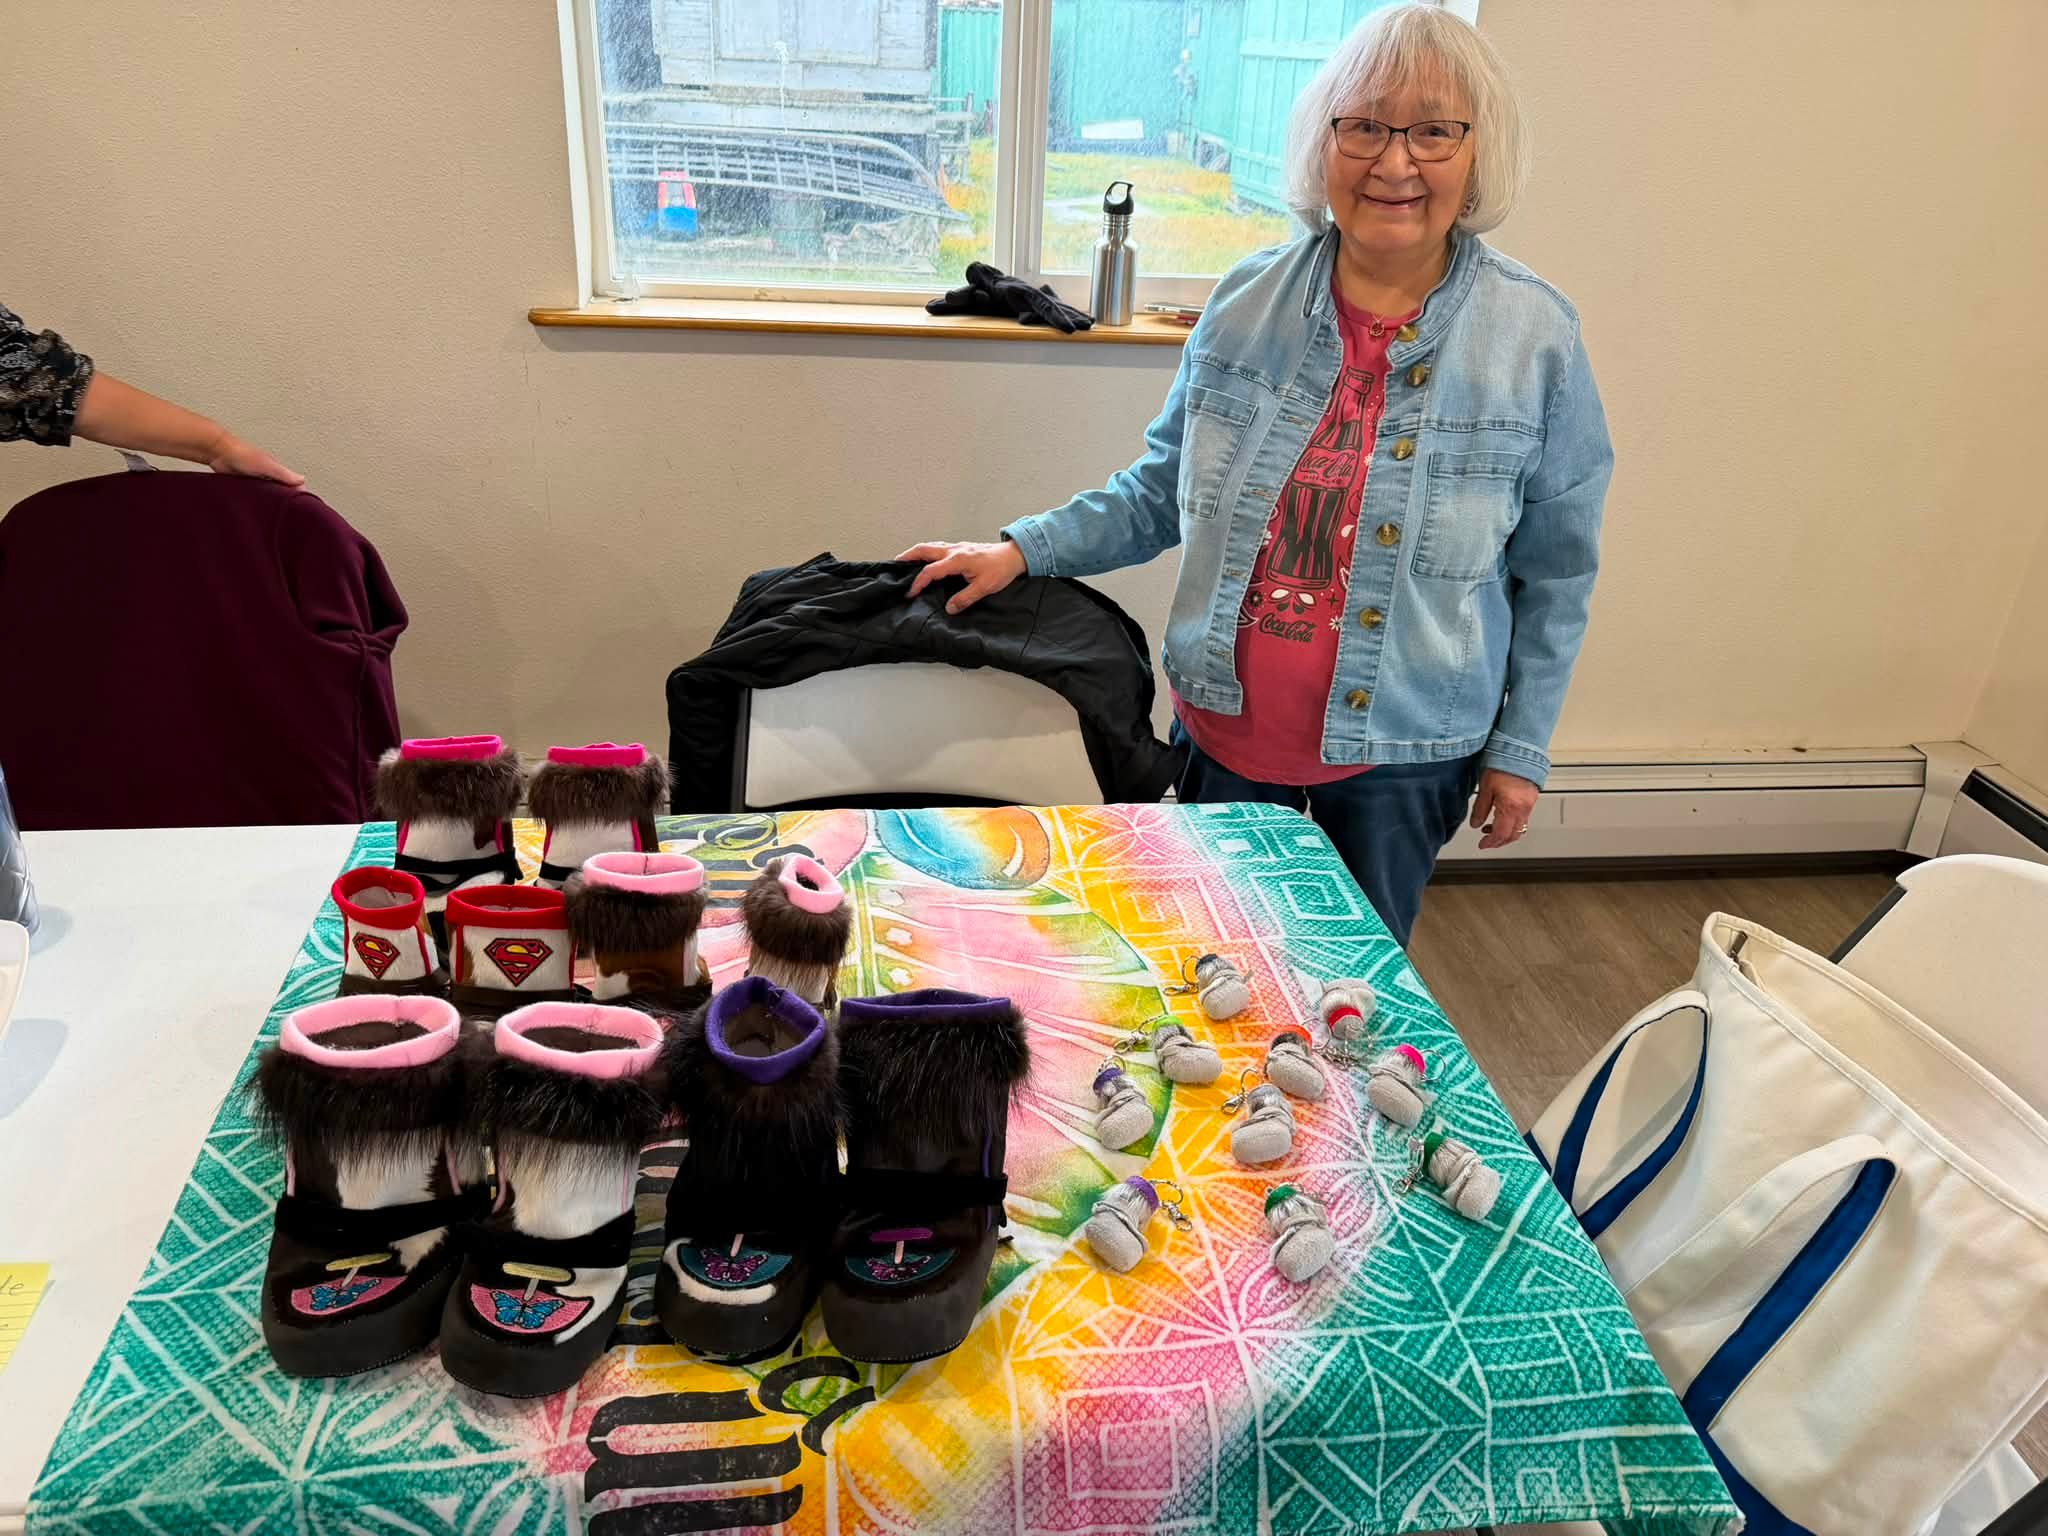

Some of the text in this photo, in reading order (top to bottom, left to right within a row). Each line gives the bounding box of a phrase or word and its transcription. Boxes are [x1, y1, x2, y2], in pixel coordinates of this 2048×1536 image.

[1299, 451, 1356, 479] Coca-Cola
[1260, 613, 1316, 642] Coca-Cola
[490, 941, 548, 981] S
